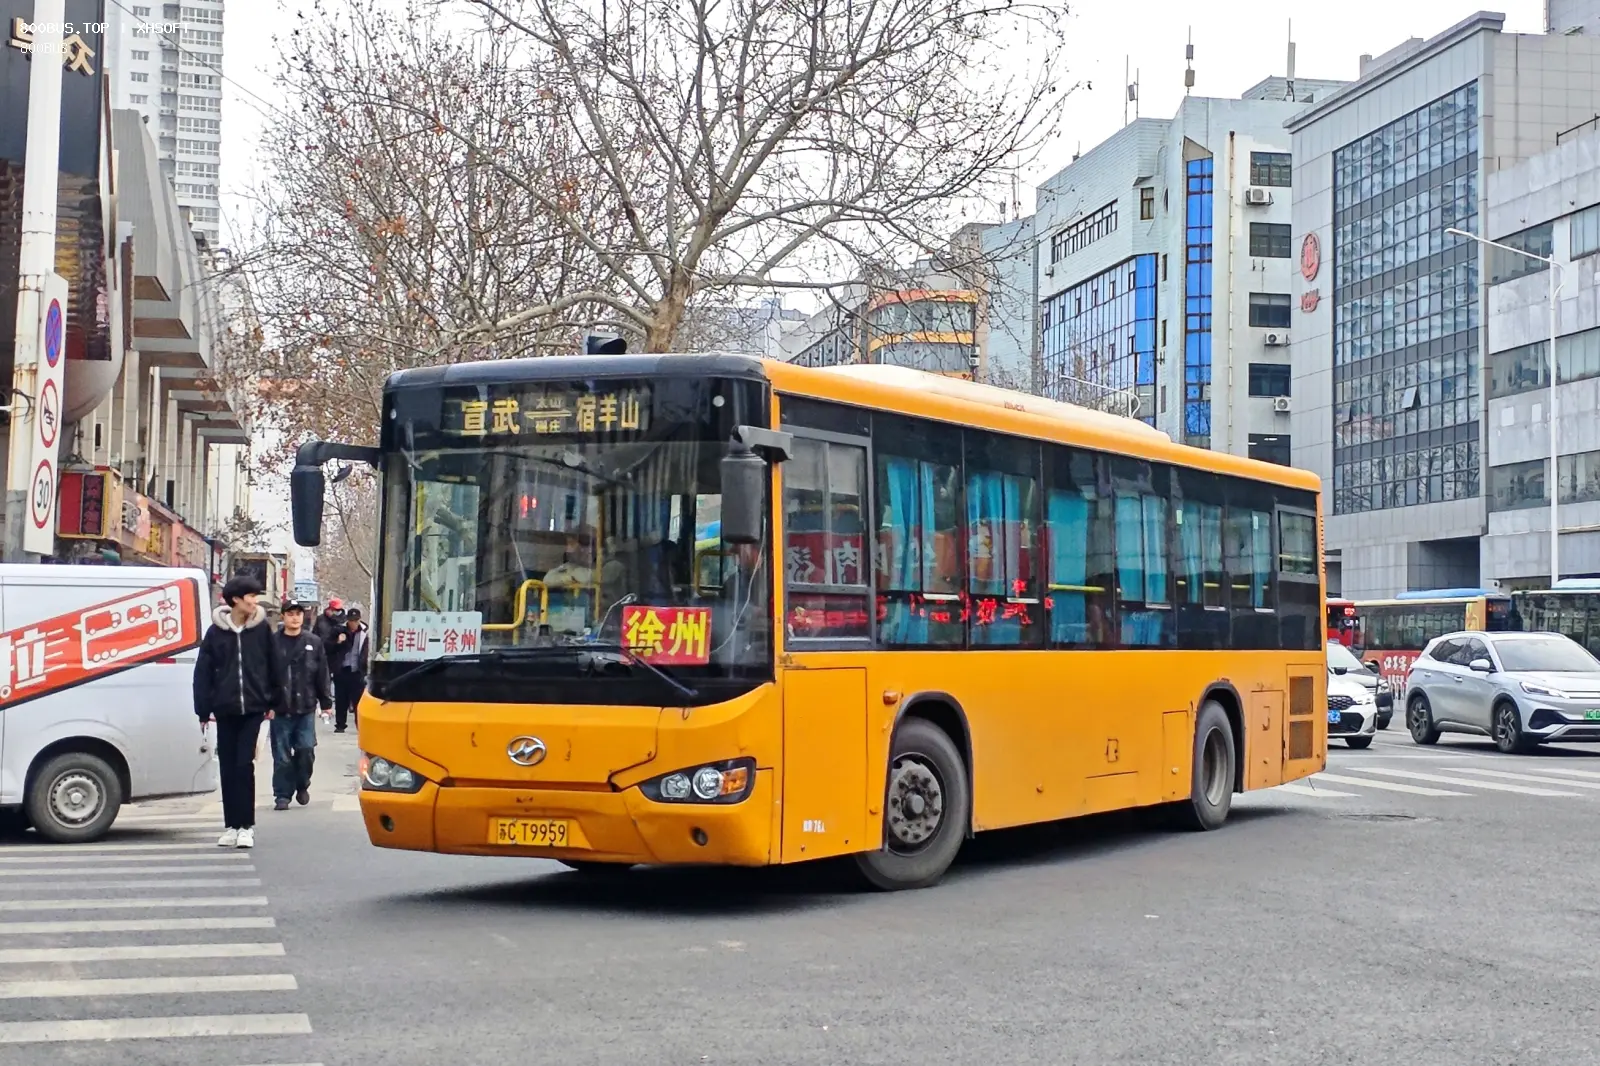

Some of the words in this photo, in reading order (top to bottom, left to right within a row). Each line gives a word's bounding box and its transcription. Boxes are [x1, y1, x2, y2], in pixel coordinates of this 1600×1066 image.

[460, 399, 520, 436] 宣武
[576, 393, 639, 433] 宿羊山
[36, 478, 50, 509] 30
[625, 610, 707, 658] 徐州
